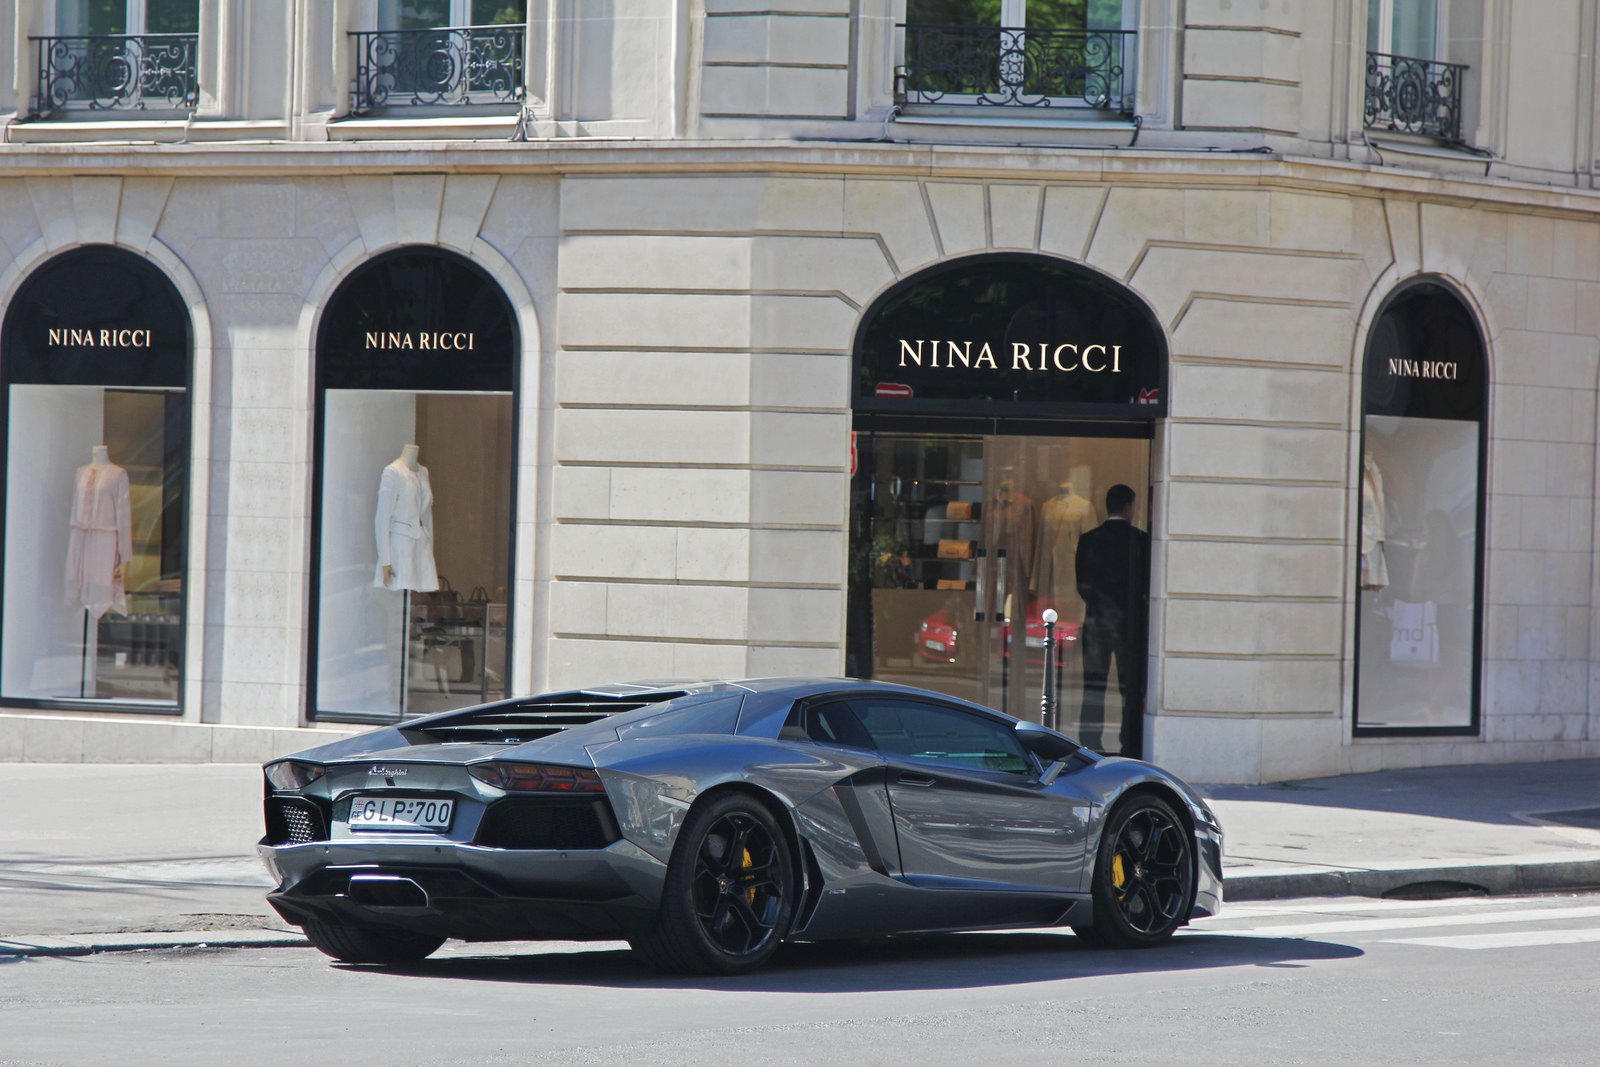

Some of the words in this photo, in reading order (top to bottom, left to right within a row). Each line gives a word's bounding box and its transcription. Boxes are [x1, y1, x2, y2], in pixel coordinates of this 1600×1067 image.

[48, 329, 95, 347] NINA
[99, 329, 152, 348] RICCI
[365, 332, 414, 349] NINA
[419, 332, 475, 350] RICCI
[898, 339, 998, 369] NINA
[1011, 342, 1122, 373] RICCI
[1388, 358, 1420, 377] NINA
[1421, 360, 1457, 380] RICCI
[363, 800, 450, 823] GLP-700
